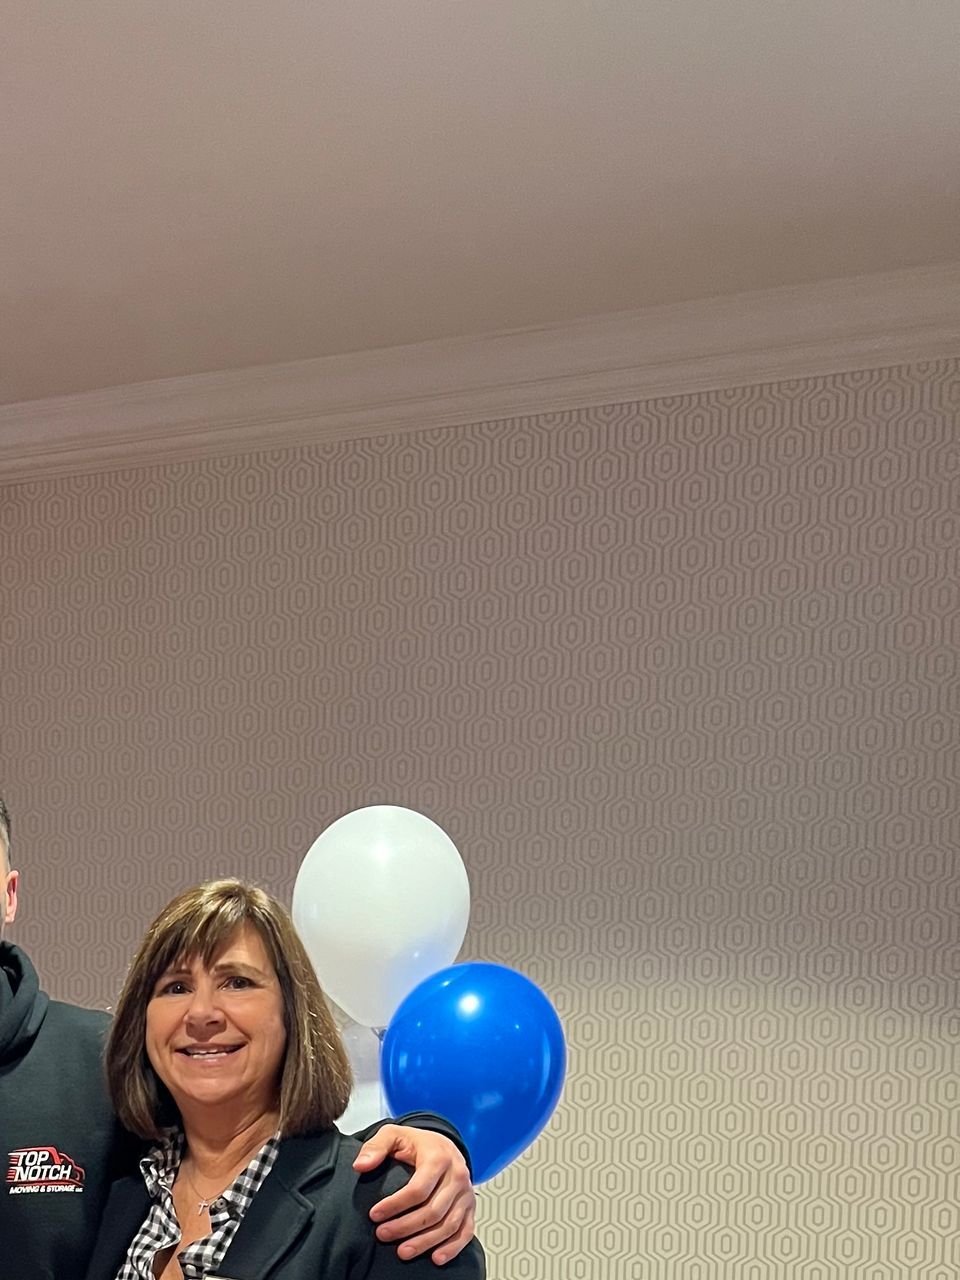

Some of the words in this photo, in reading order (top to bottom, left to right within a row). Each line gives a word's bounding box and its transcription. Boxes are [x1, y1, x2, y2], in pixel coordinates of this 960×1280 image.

[8, 1151, 50, 1166] TOP
[9, 1165, 72, 1182] NOTCH
[9, 1186, 39, 1194] MOVING
